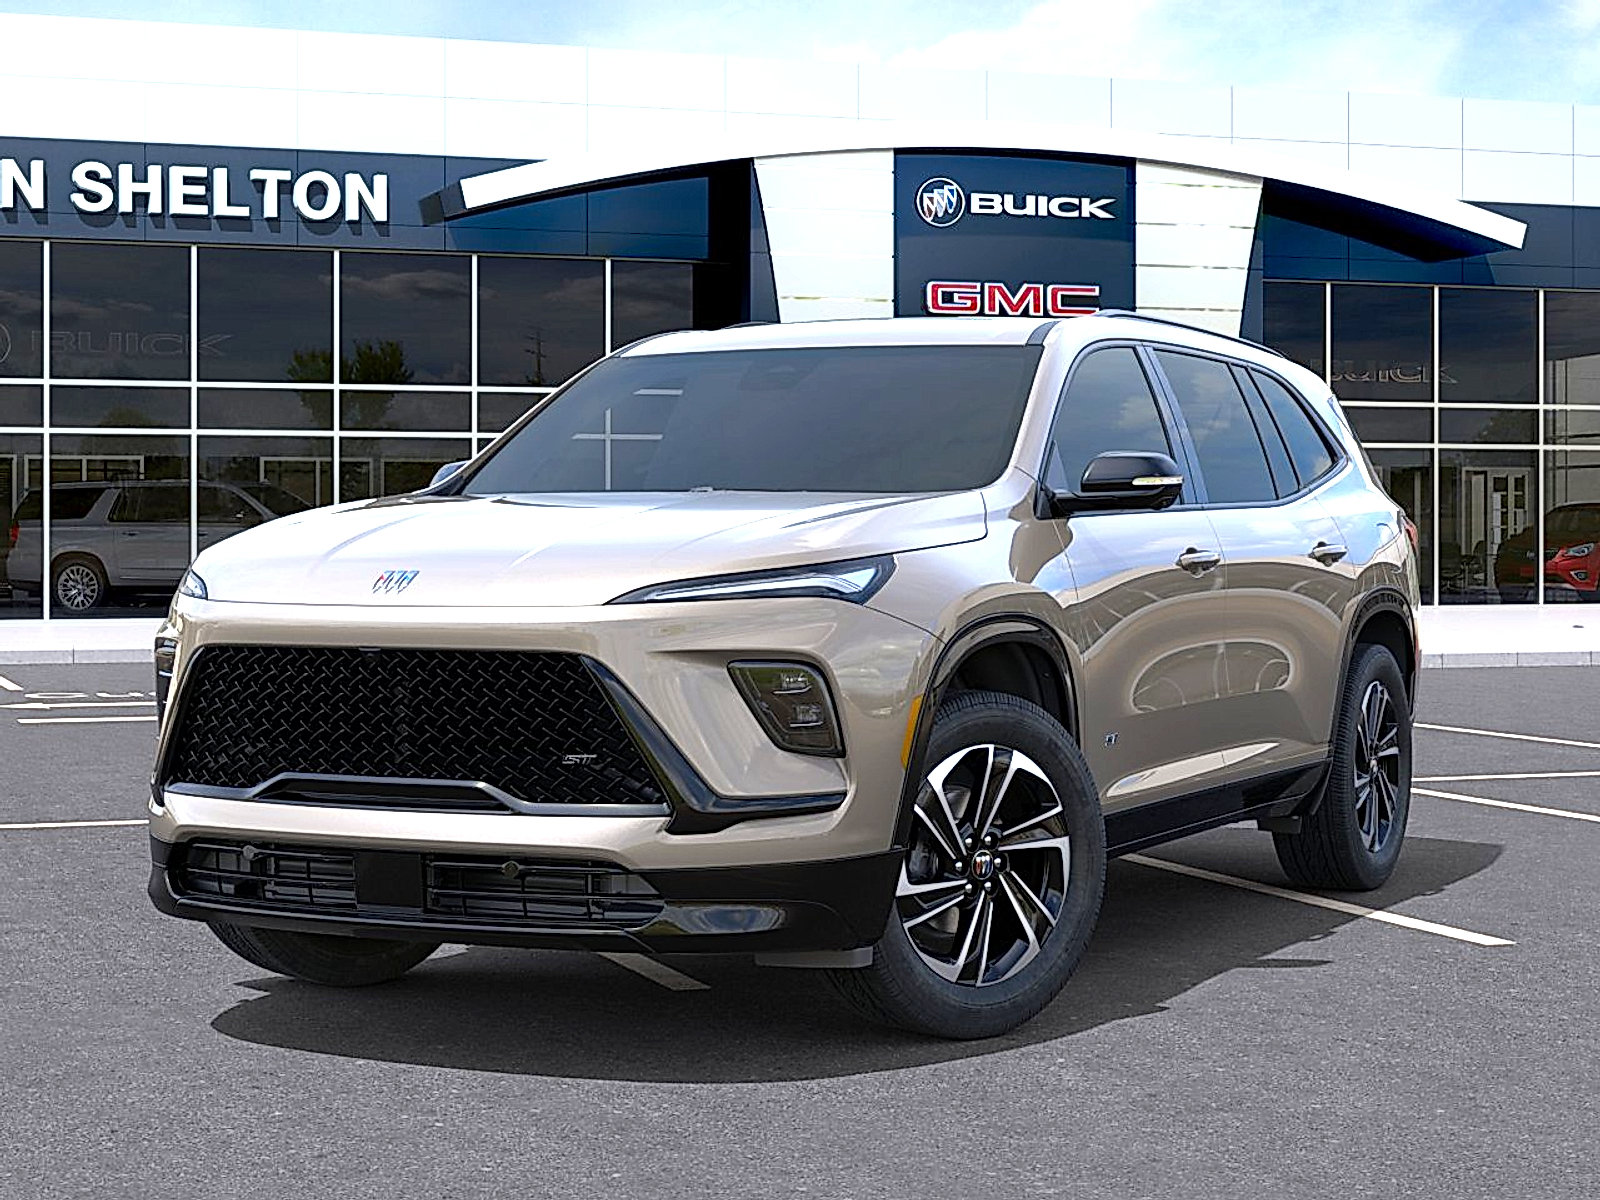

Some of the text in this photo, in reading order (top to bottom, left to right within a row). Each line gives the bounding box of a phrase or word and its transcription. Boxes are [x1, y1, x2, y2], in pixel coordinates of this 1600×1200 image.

[0, 158, 389, 222] N SHELTON
[970, 192, 1117, 219] BUICK
[926, 280, 1100, 316] GMC
[31, 330, 235, 355] BUICK
[562, 754, 598, 765] ST
